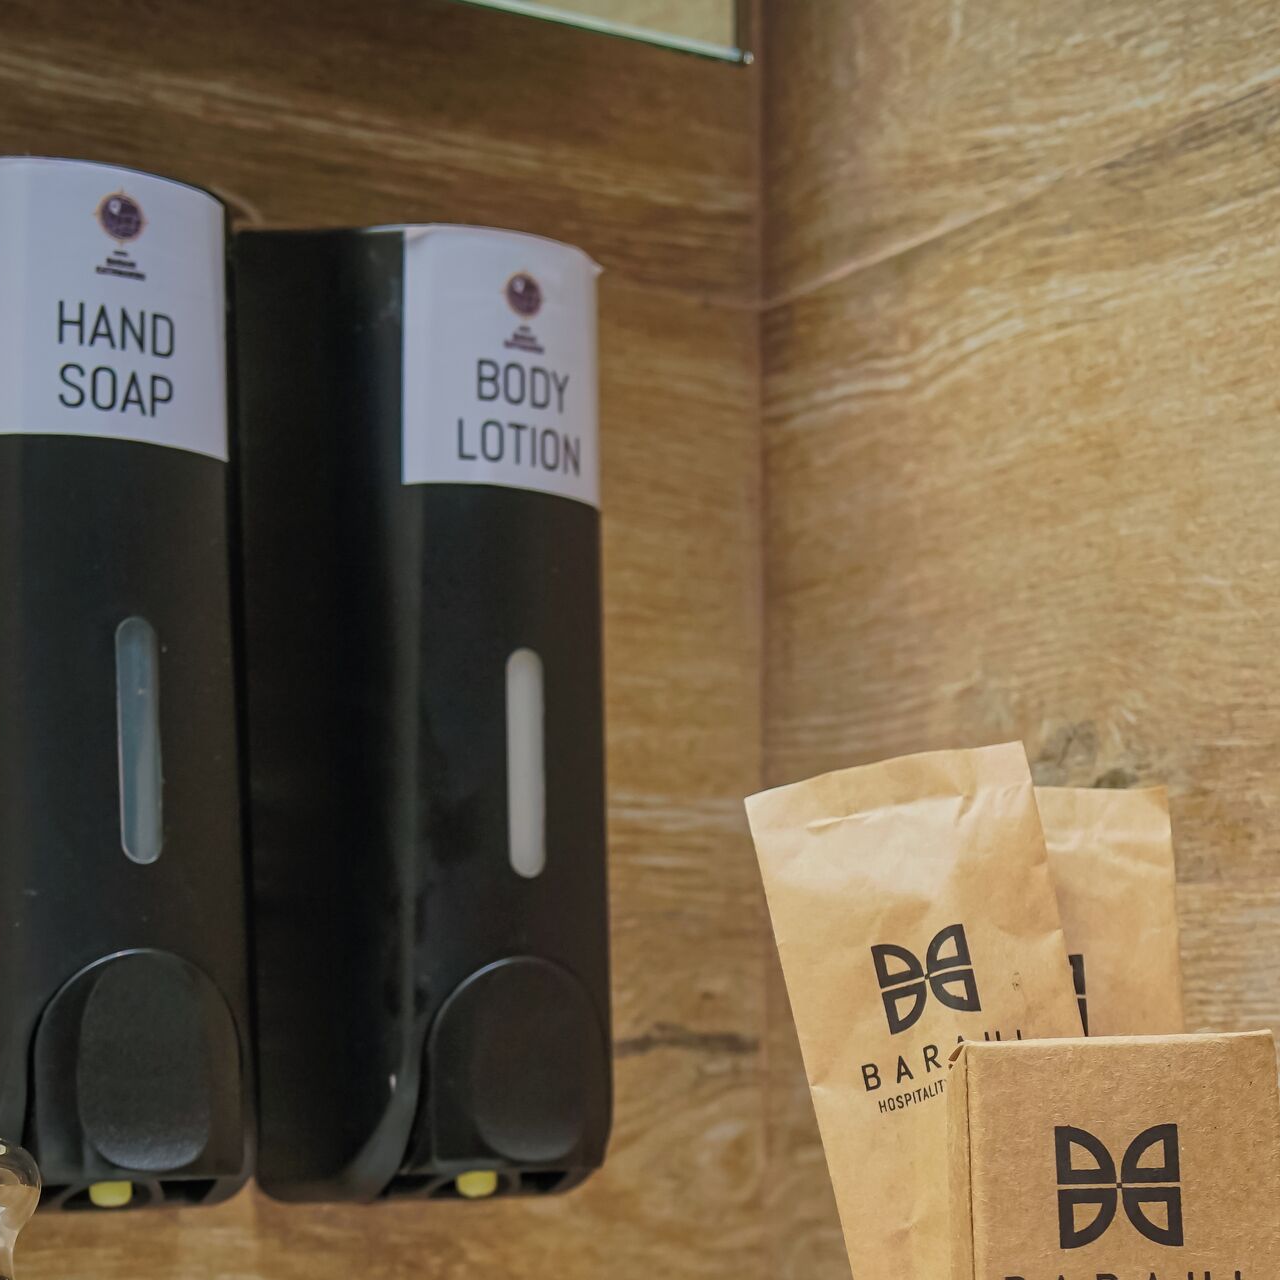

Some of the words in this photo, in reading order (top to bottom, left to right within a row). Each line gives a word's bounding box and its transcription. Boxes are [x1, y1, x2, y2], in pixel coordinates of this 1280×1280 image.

[57, 300, 175, 359] HAND
[58, 363, 174, 418] SOAP
[477, 359, 569, 413] BODY
[457, 418, 580, 477] LOTION
[878, 1078, 948, 1114] HOSPITALIT
